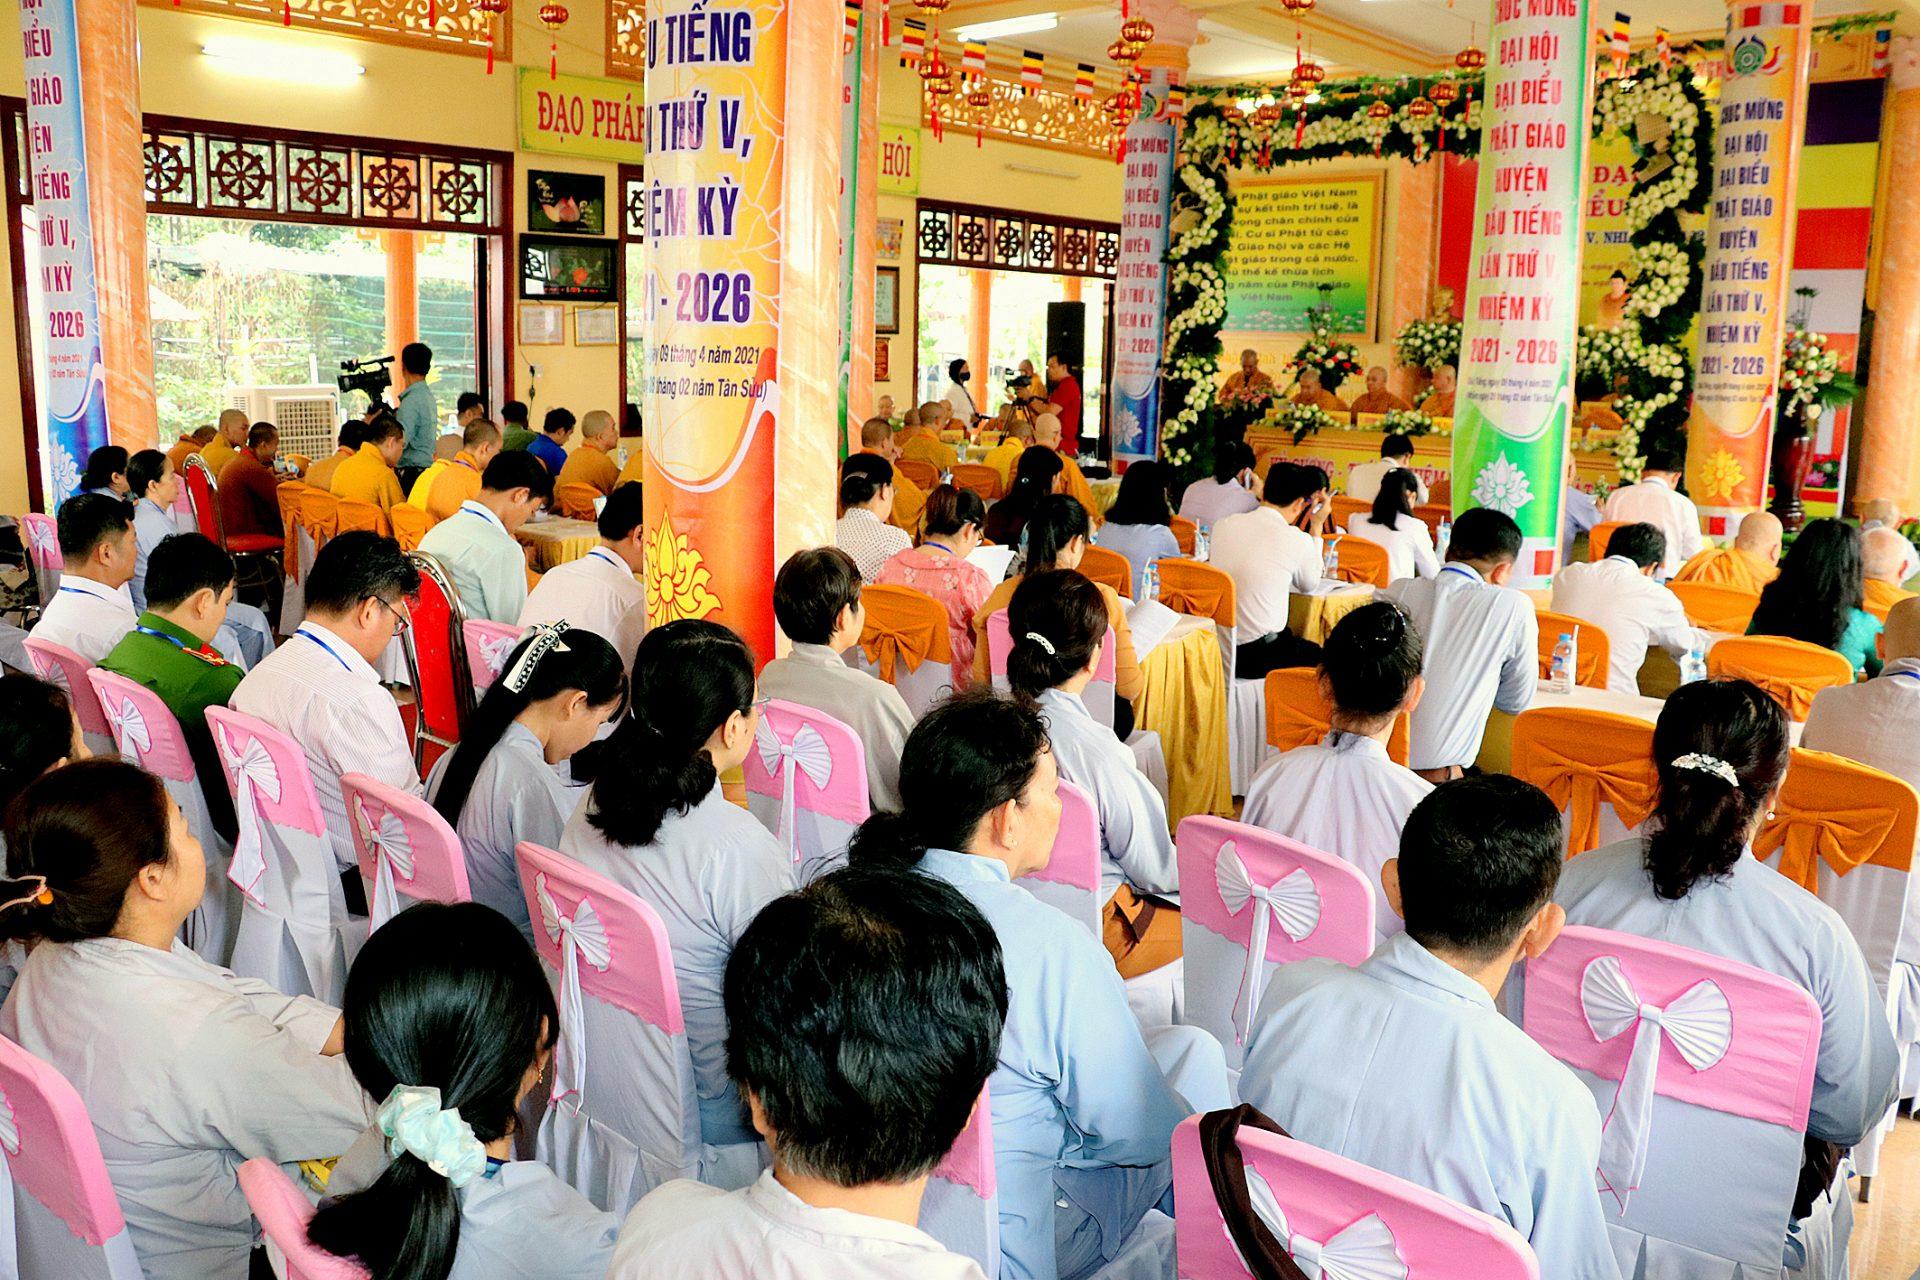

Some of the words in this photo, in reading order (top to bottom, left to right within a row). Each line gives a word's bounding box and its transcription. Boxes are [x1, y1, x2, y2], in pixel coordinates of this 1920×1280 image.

[665, 0, 751, 64] TIẾNG
[1500, 36, 1524, 68] ĐẠI
[1529, 29, 1560, 67] HỘI
[31, 72, 62, 106] GIÁO
[1494, 81, 1516, 112] ĐẠI
[1521, 69, 1562, 105] BIỂU
[537, 91, 584, 143] ĐẠO
[659, 90, 707, 152] THỨ
[720, 100, 751, 158] V,
[1745, 98, 1784, 121] MỪNG
[1489, 120, 1520, 155] PHẬT
[1526, 117, 1566, 149] GIÁO
[1724, 133, 1742, 158] ĐẠI
[1745, 129, 1768, 157] HỘI
[882, 134, 911, 185] HỘI
[1738, 158, 1770, 185] BIỂU
[1241, 190, 1268, 201] Phật
[1271, 190, 1298, 202] giáo
[1301, 189, 1326, 199] Việt
[1329, 188, 1358, 197] Nam
[1495, 162, 1548, 198] HUYỆN
[698, 176, 739, 236] KỲ
[1513, 202, 1562, 236] TIẾNG
[1741, 195, 1772, 217] GIÁO
[60, 219, 76, 250] V,
[1237, 241, 1265, 252] Giáo
[1719, 226, 1758, 253] HUYỆN
[1270, 254, 1302, 265] trong
[1479, 247, 1500, 279] LẦN
[1507, 248, 1539, 279] THỨ
[1731, 256, 1769, 280] TIẾNG
[54, 260, 73, 292] KỲ
[676, 272, 750, 323] 2026
[1478, 291, 1525, 327] NHIỆM
[1531, 294, 1554, 322] KỲ
[1726, 288, 1750, 312] THỨ
[1754, 294, 1767, 314] V,
[50, 311, 85, 338] 2026
[1706, 322, 1738, 348] NHIỆM
[1743, 320, 1761, 344] KỲ
[660, 344, 669, 362] 09
[670, 344, 697, 367] tháng
[699, 345, 705, 363] 4
[708, 344, 731, 364] năm
[734, 346, 760, 364] 2021
[1470, 338, 1500, 363] 2021
[1516, 338, 1558, 365] 2026
[1732, 356, 1764, 375] 2026
[679, 378, 690, 396] 02
[692, 378, 714, 397] năm
[718, 378, 738, 398] Tân
